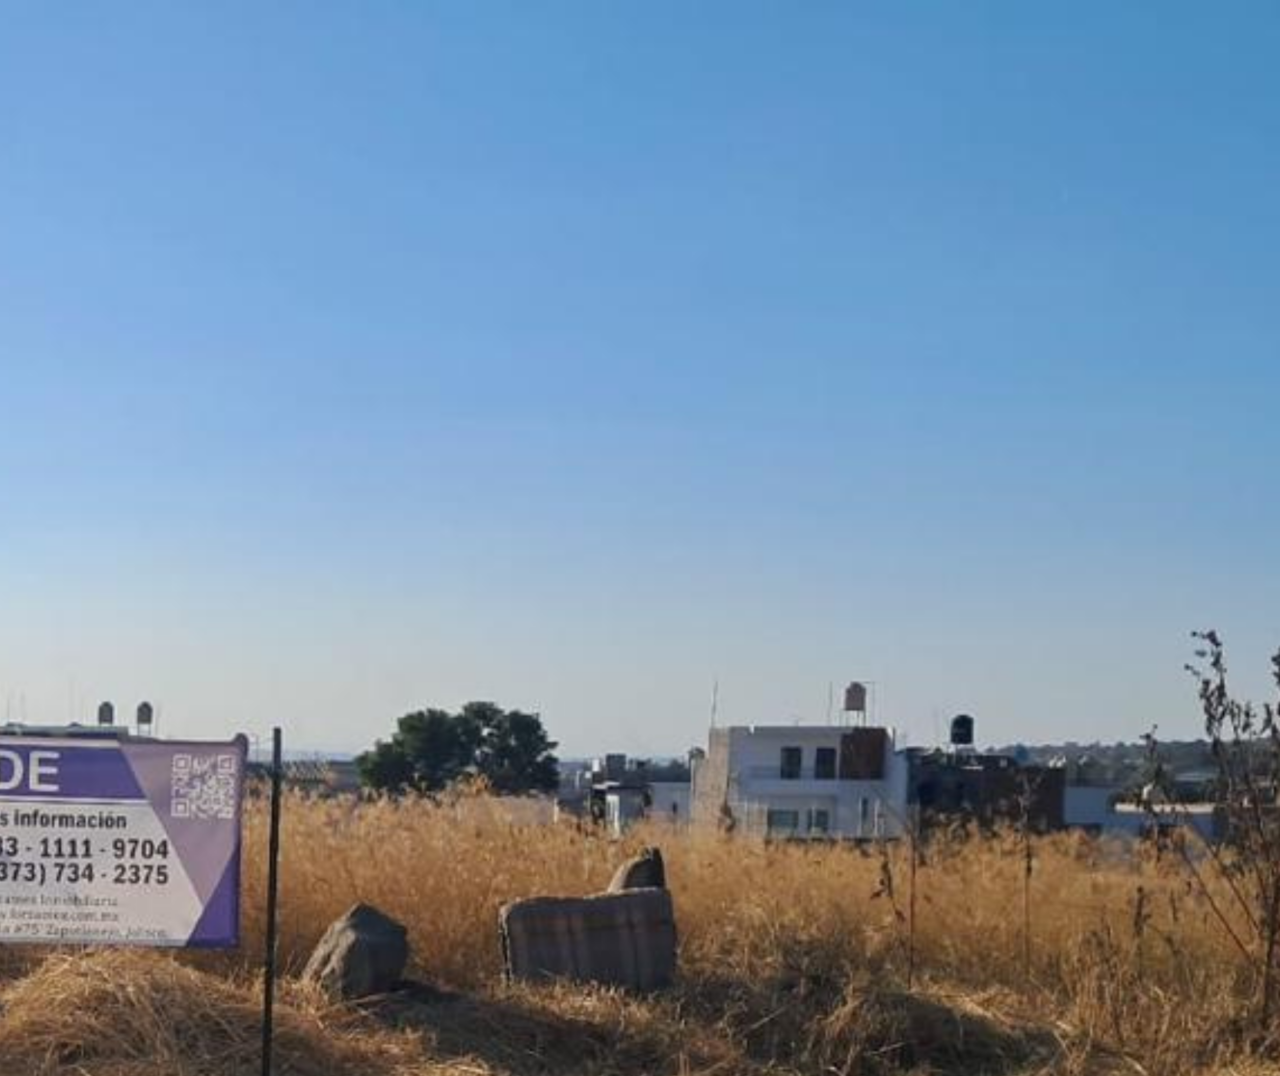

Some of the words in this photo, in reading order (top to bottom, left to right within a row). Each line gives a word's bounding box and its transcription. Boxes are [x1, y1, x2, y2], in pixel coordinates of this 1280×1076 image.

[14, 810, 127, 829] información
[40, 838, 93, 859] 1111
[112, 840, 169, 860] 9704
[54, 864, 94, 883] 734
[113, 864, 169, 884] 2375
